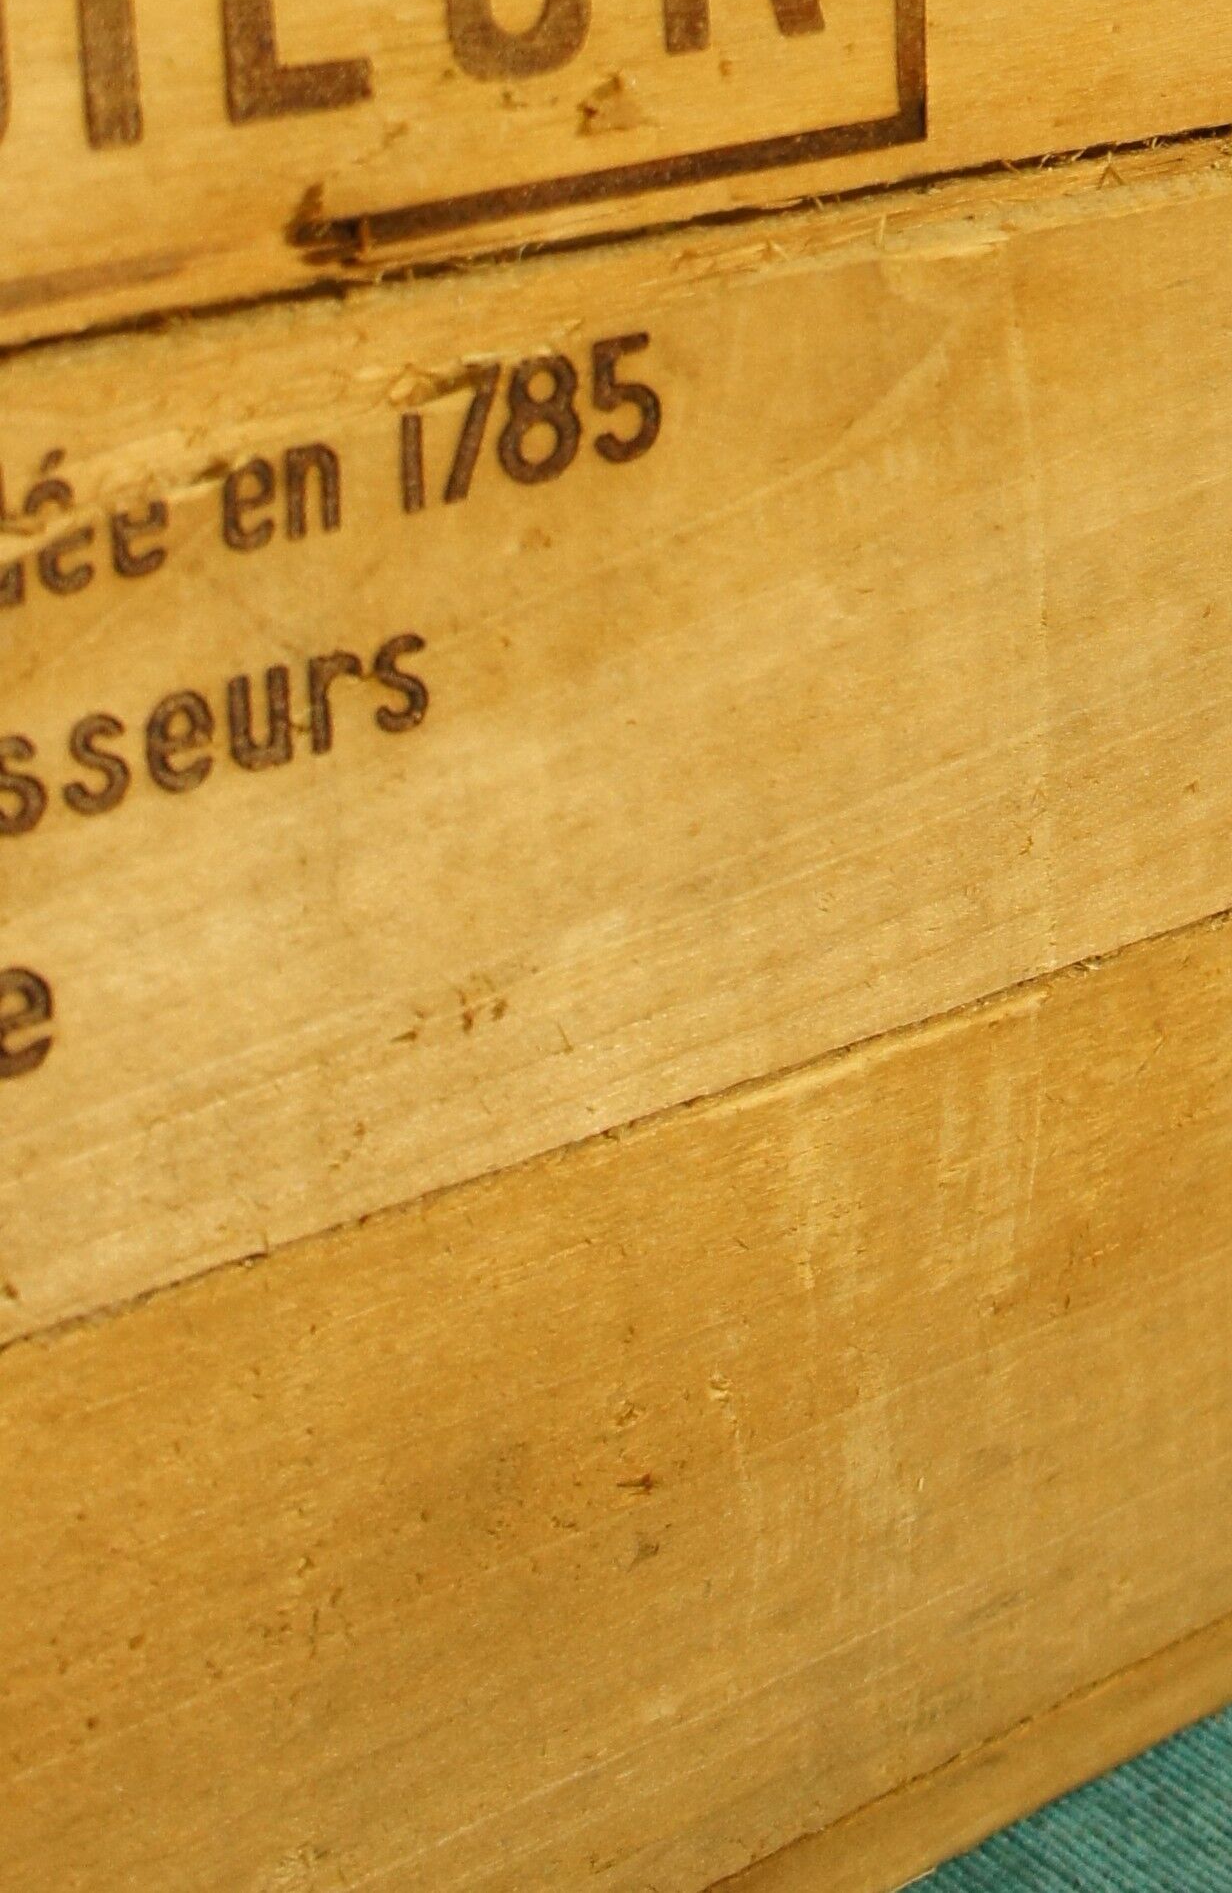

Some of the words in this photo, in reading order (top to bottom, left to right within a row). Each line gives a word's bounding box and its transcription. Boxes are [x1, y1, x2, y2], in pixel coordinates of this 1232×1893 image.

[221, 443, 341, 552] en
[399, 332, 662, 514] 1785
[0, 633, 430, 838] sseurs
